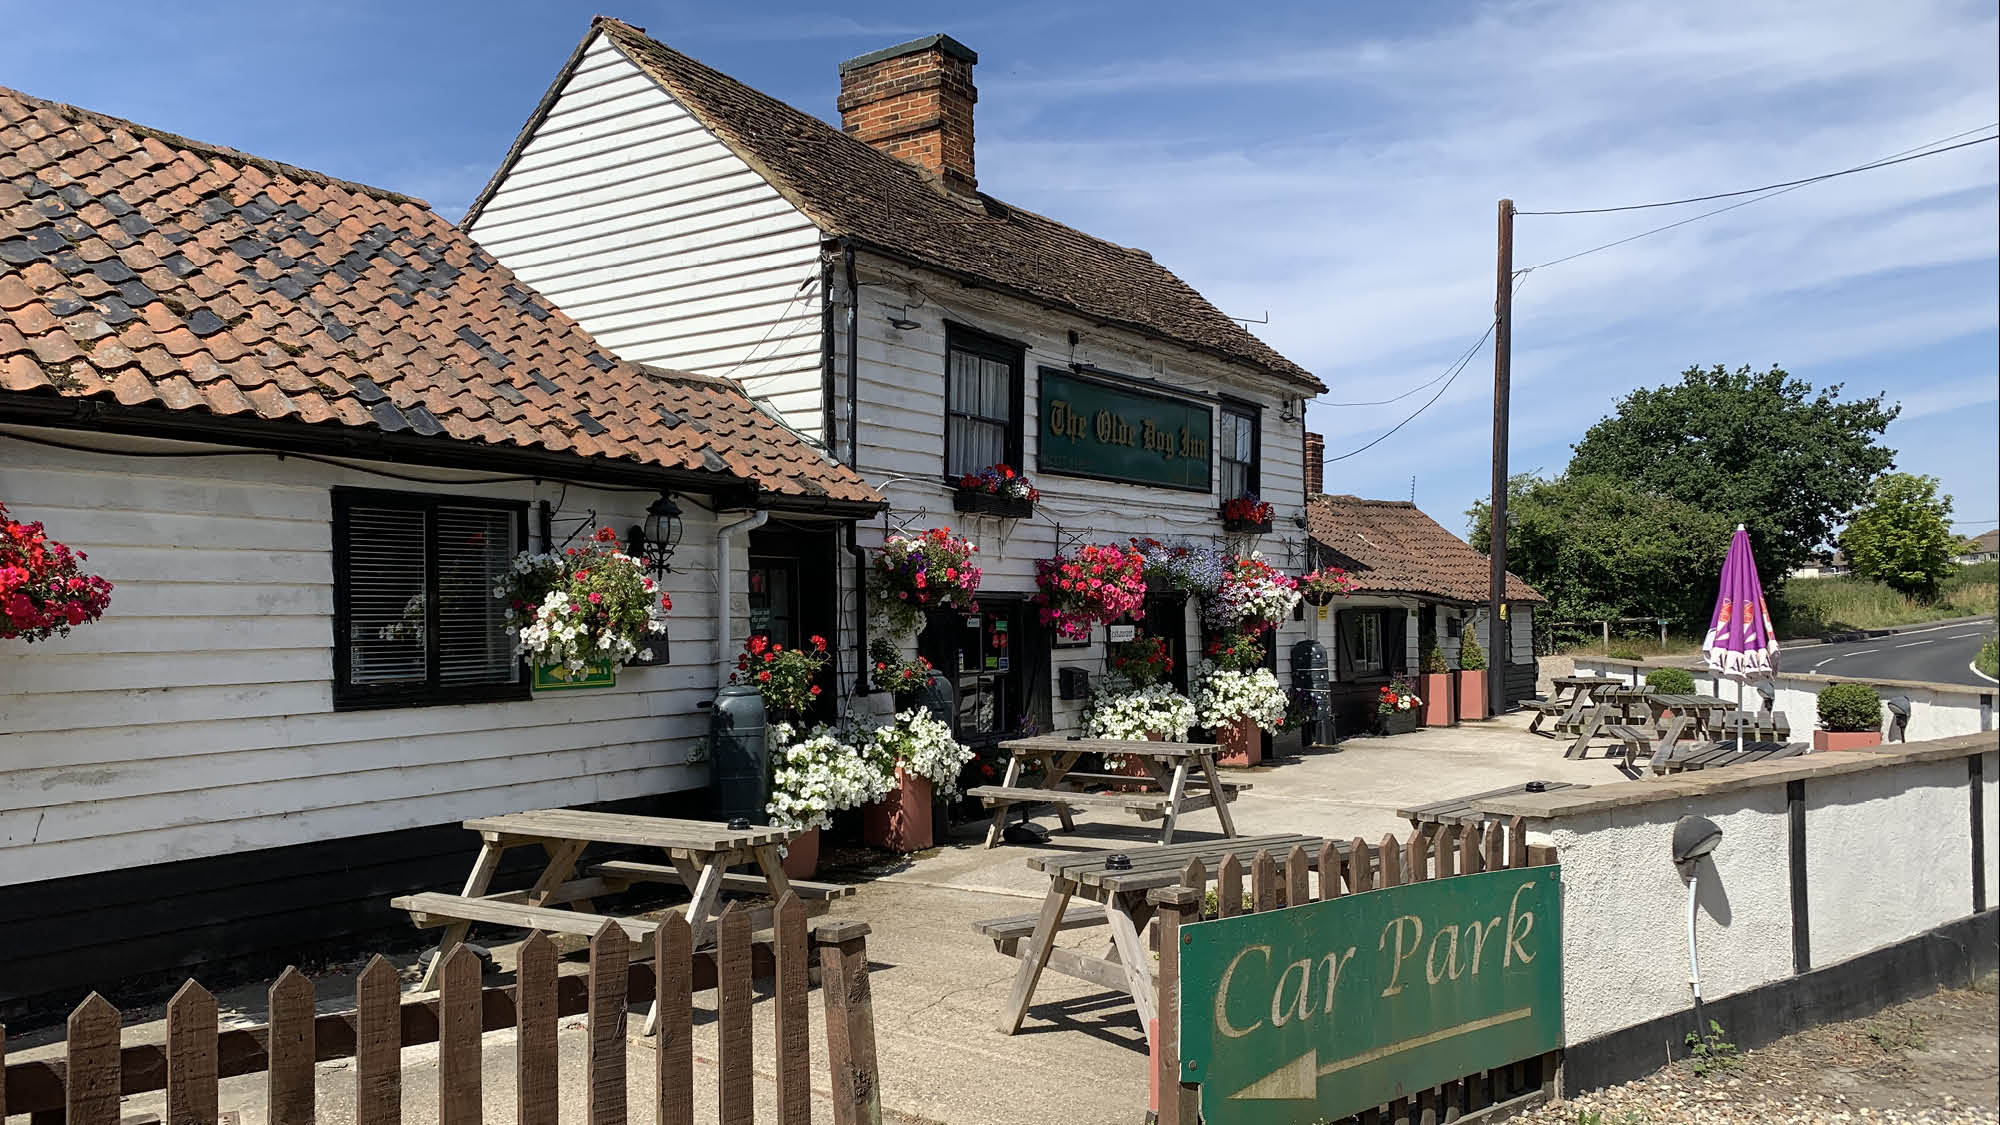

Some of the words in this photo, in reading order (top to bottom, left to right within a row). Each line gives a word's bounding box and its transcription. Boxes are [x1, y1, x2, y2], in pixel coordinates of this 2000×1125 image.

[1051, 401, 1087, 444] The
[1097, 408, 1136, 447] Olde
[1144, 419, 1174, 460] Dog
[1179, 428, 1208, 461] Inn
[1215, 944, 1356, 1039] Car
[1378, 880, 1537, 998] Park
